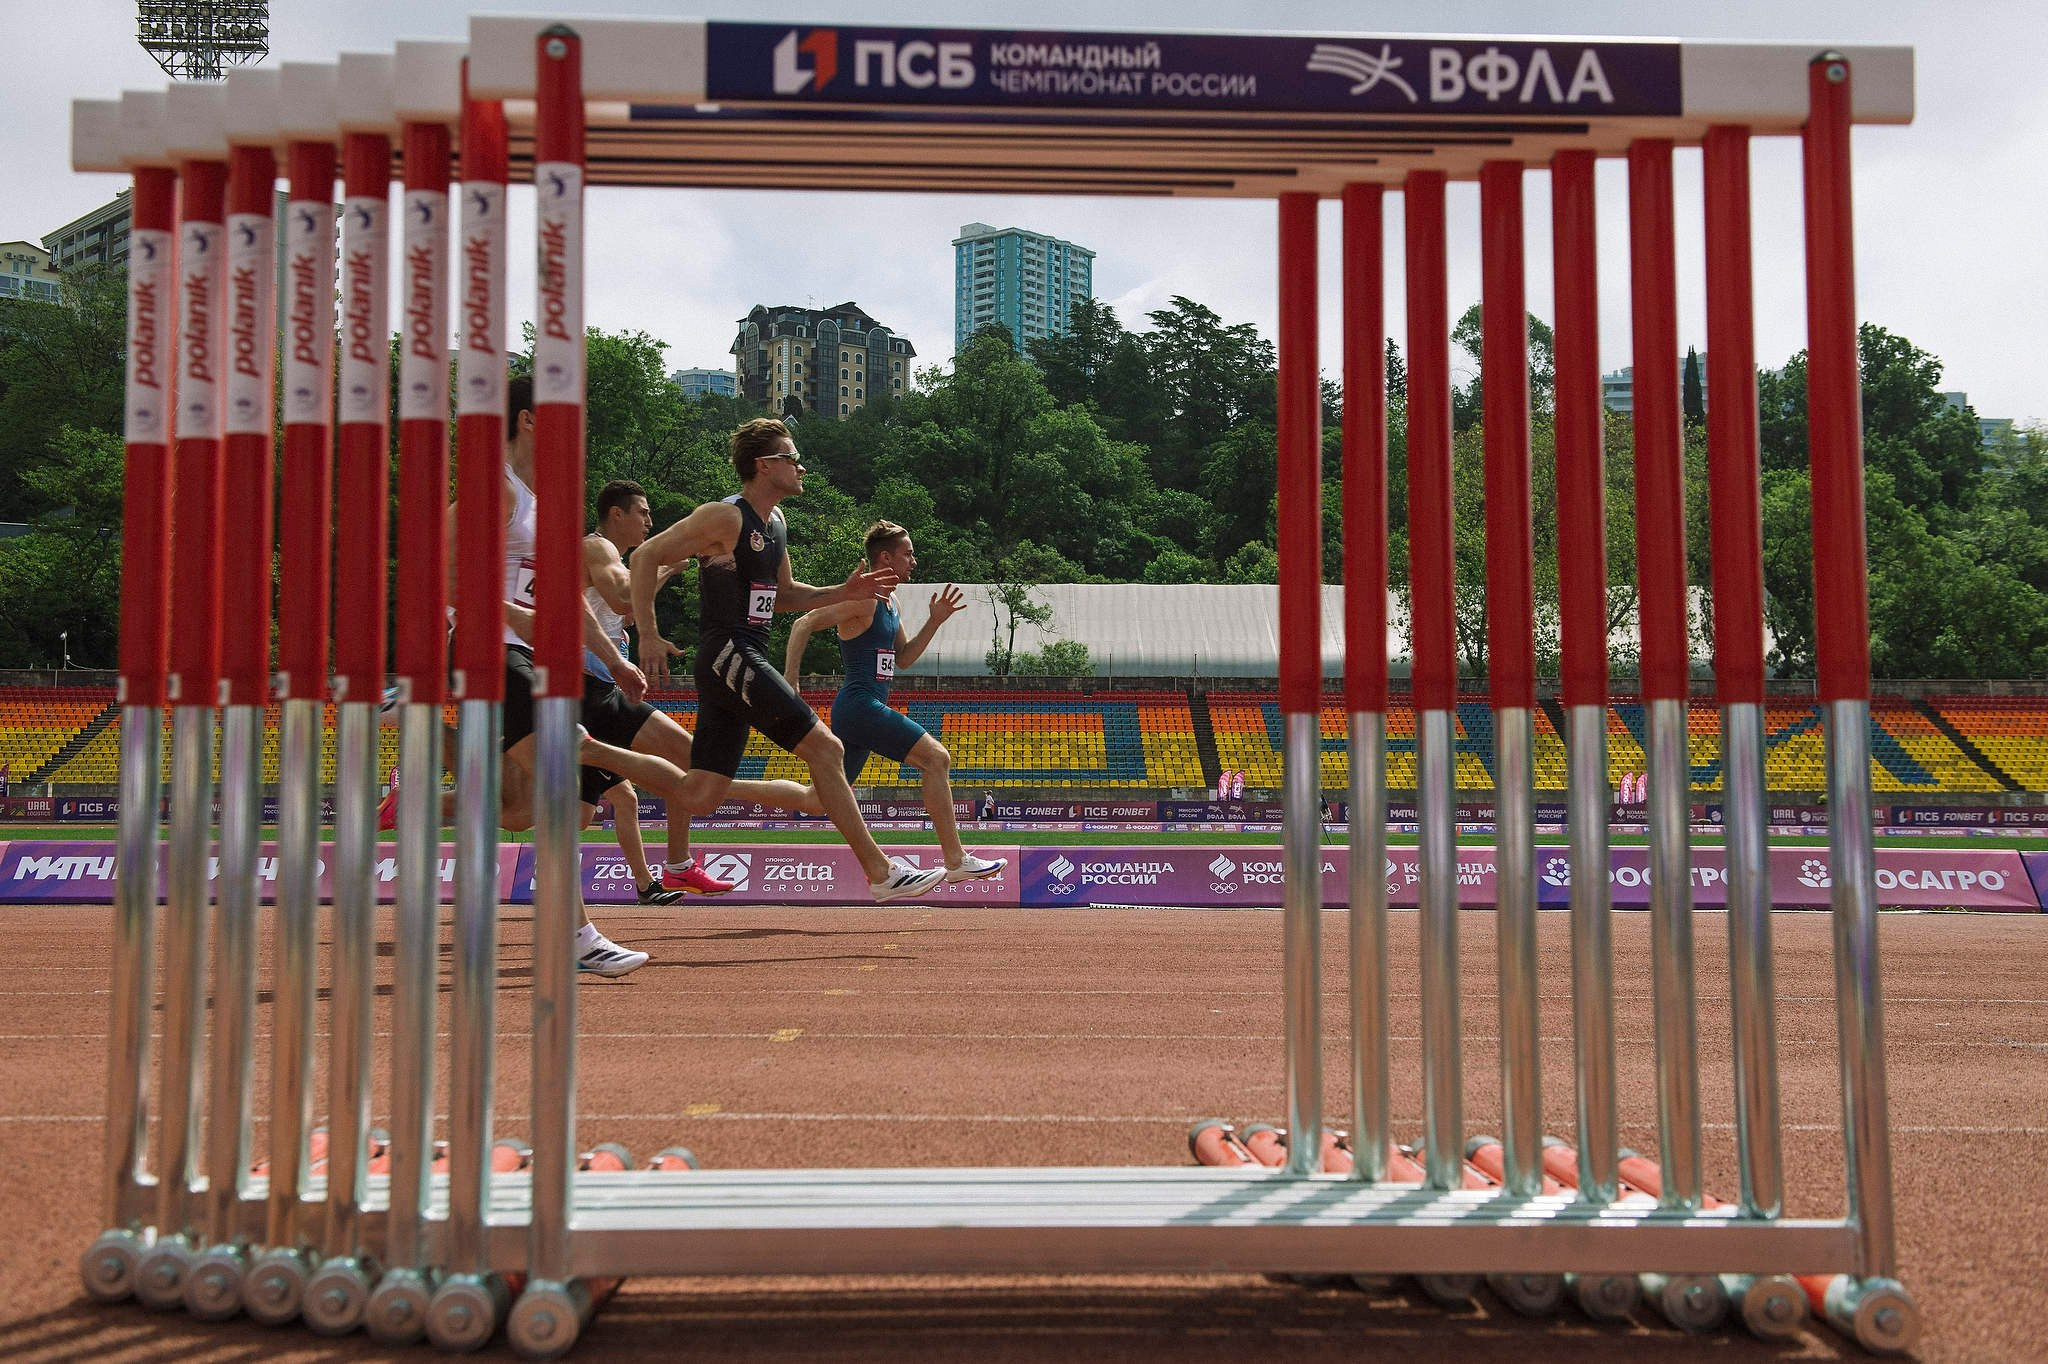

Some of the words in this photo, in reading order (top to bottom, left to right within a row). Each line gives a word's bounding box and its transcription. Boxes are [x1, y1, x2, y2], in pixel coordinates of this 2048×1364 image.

[990, 42, 1161, 69] КОМАНДНЫЙ
[854, 41, 975, 88] ПСБ
[991, 70, 1148, 94] ЧЕМПИОНАТ
[1151, 72, 1258, 97] РОССИИ
[1429, 48, 1615, 103] ВФЛА
[541, 220, 573, 342] polanik
[408, 245, 438, 362] polanik
[464, 237, 495, 356] polanik
[290, 254, 321, 368] polanik
[347, 251, 377, 366] polanik
[184, 273, 215, 385] polanik
[232, 266, 262, 379] polanik
[133, 281, 162, 390] polanik
[756, 596, 775, 612] 28
[28, 801, 50, 810] URAL
[79, 803, 103, 813] ПСБ
[860, 804, 882, 814] URAL
[954, 804, 970, 813] RAL
[998, 807, 1021, 816] ПСБ
[1025, 807, 1064, 816] FONBET
[1084, 807, 1108, 817] ПСБ
[1112, 807, 1151, 816] FONBET
[1455, 809, 1471, 817] etta
[1773, 809, 1796, 818] URAL
[1915, 812, 1940, 821] ПСБ
[1943, 812, 1984, 821] FONBET
[2004, 812, 2029, 822] ПСБ
[14, 856, 118, 880] МАТЧ
[763, 862, 834, 881] zetta
[1081, 862, 1175, 874] КОМАНДА
[1403, 863, 1497, 875] КНДА
[1081, 874, 1157, 885] РОССИИ
[1874, 869, 2005, 891] ОСАГРО
[762, 884, 834, 892] GROUP
[932, 885, 1005, 893] GROUP
